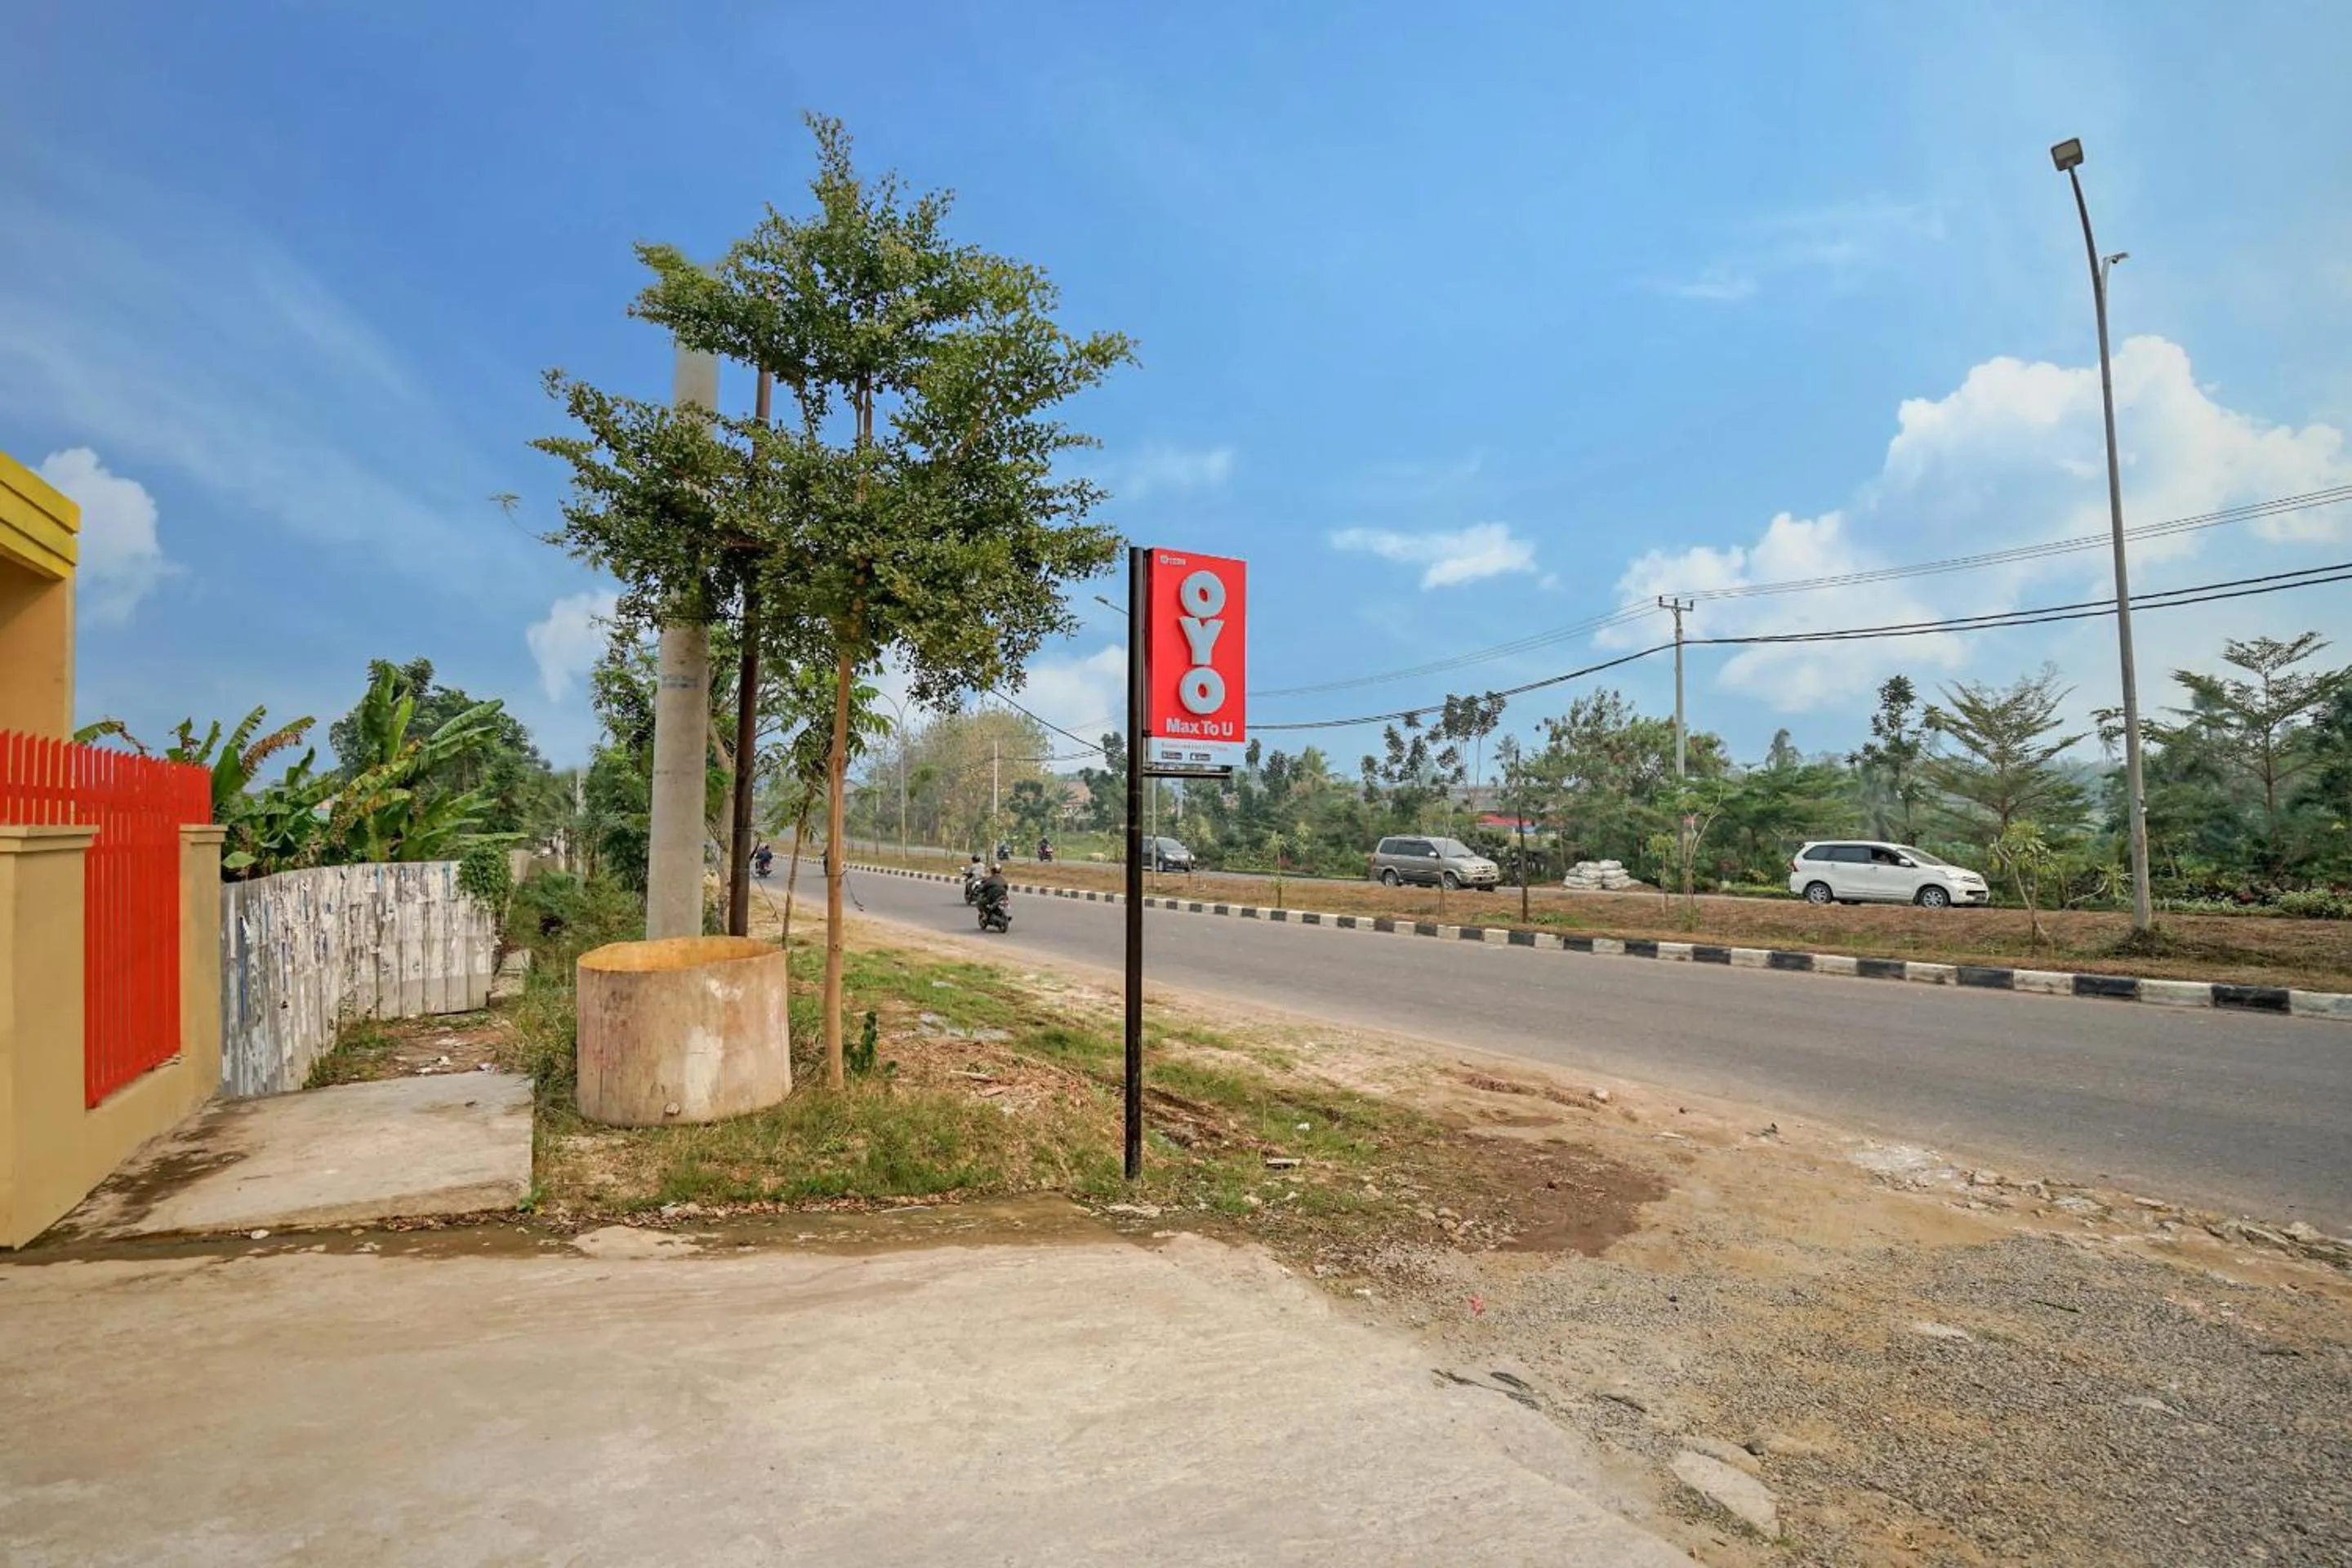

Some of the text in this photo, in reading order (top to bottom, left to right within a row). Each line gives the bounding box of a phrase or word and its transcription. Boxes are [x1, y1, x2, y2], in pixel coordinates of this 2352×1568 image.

[1178, 570, 1227, 715] OYO
[1165, 718, 1234, 737] Max To U
